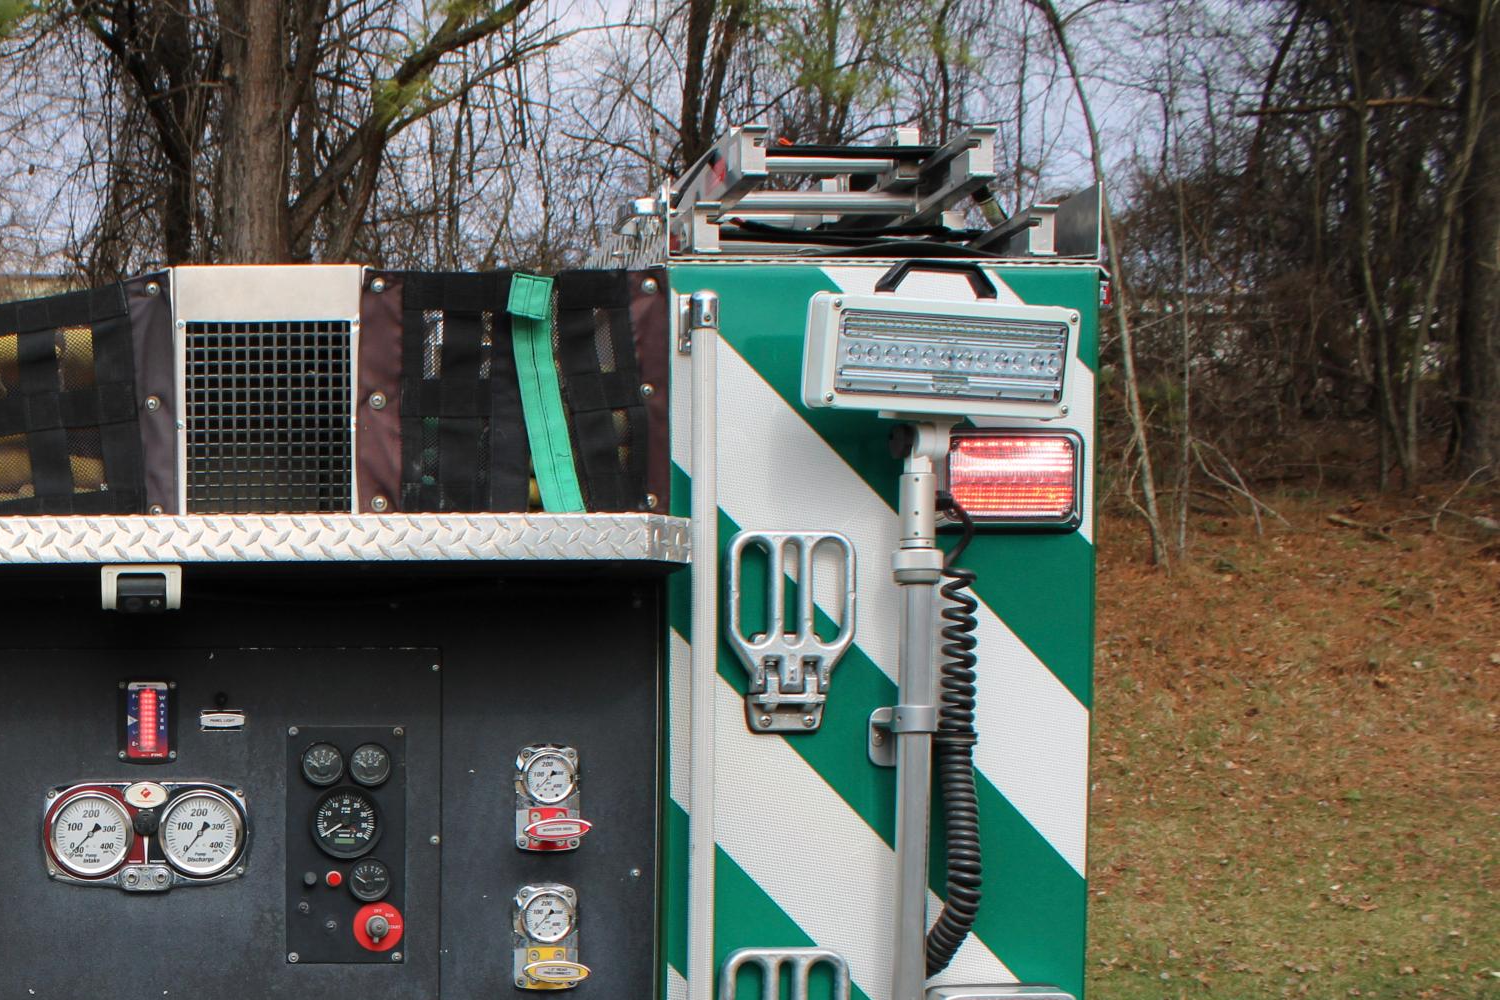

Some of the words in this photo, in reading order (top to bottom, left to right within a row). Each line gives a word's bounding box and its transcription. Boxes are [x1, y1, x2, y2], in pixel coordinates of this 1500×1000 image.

[158, 695, 166, 731] WATER
[82, 809, 100, 818] 200
[190, 808, 208, 817] 200
[67, 822, 83, 831] 100
[102, 825, 116, 833] 300
[177, 822, 193, 831] 100
[211, 823, 226, 831] 300
[100, 842, 114, 850] 400
[209, 841, 224, 849] 400
